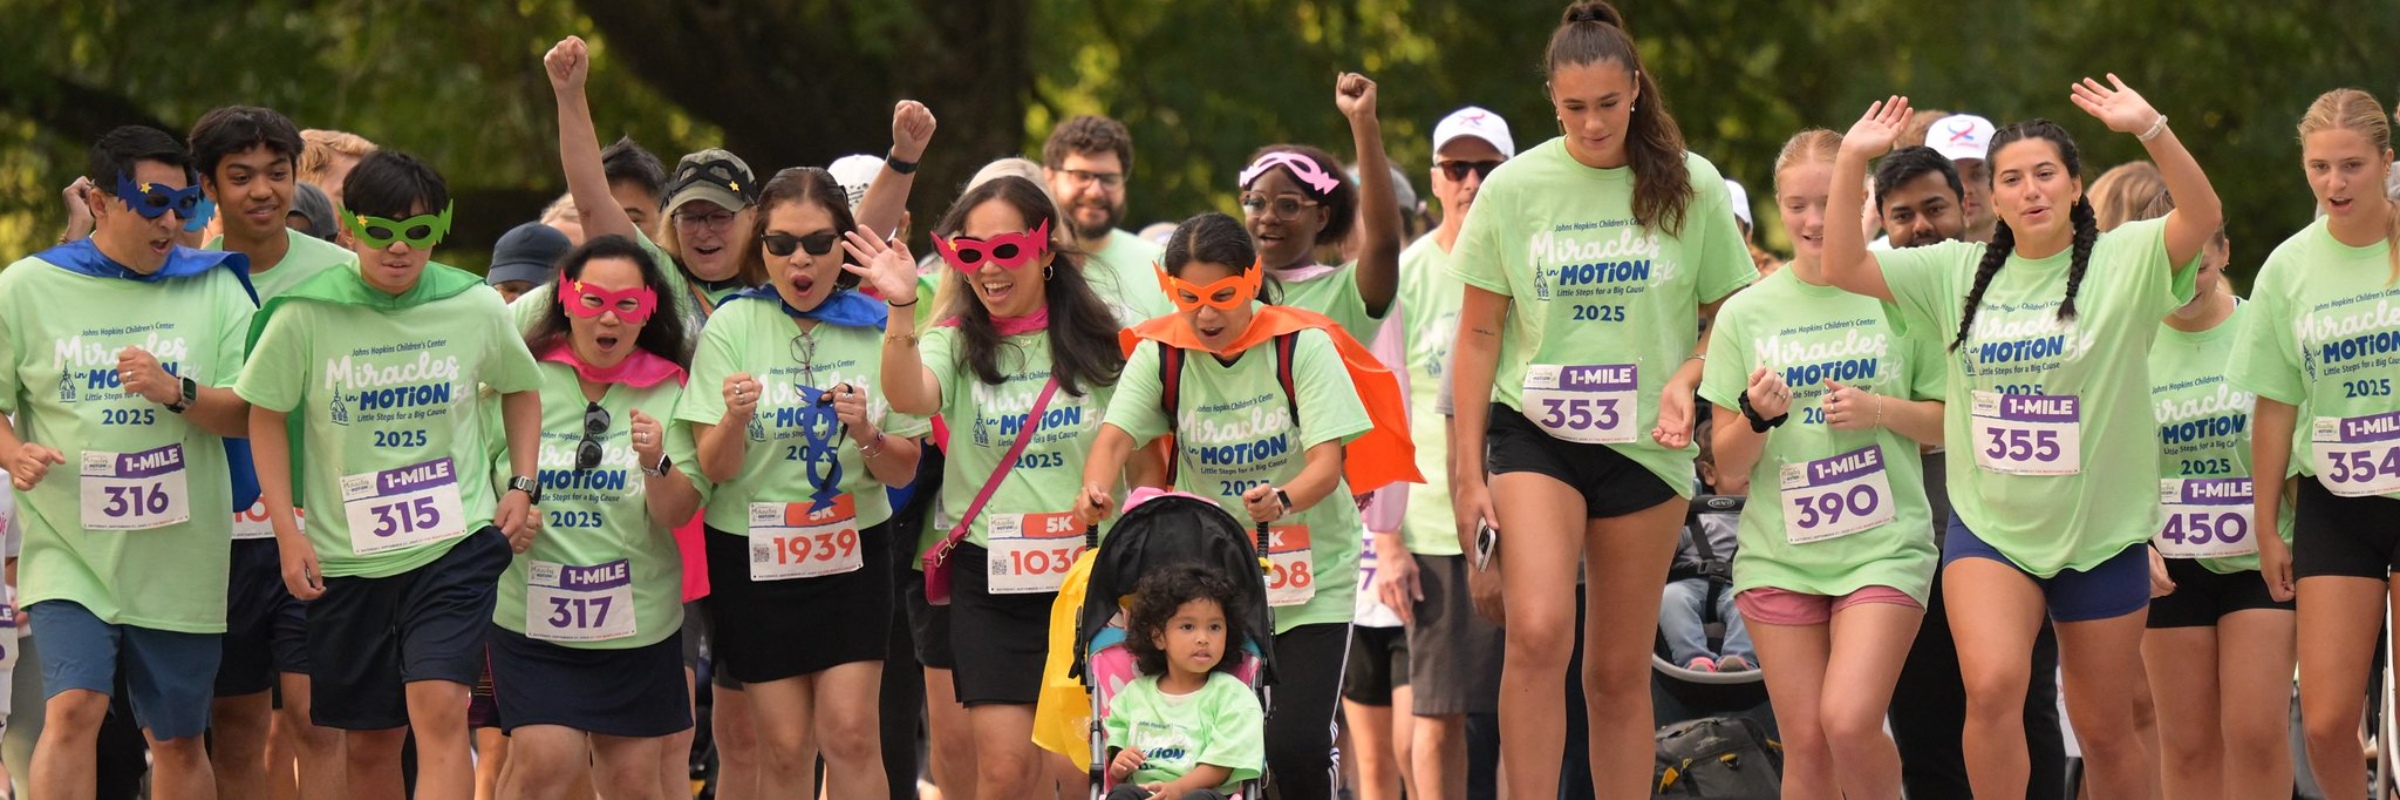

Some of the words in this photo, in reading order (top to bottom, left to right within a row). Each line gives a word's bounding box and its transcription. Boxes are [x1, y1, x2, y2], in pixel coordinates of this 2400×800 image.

[1574, 222, 1598, 231] Hopkins
[1529, 228, 1660, 267] Miracles
[1575, 287, 1594, 297] Steps
[1573, 304, 1625, 322] 2025
[100, 326, 124, 337] Hopkins
[155, 321, 175, 329] Center
[1798, 324, 1823, 334] Hopkins
[1856, 318, 1876, 326] Center
[2296, 299, 2400, 350] Miracle
[371, 346, 395, 355] Hopkins
[396, 342, 426, 352] Children's
[427, 340, 446, 348] Center
[1755, 329, 1889, 368] Miracles
[325, 351, 459, 390] Miracles
[837, 359, 856, 367] Center
[1995, 366, 2012, 376] Steps
[1570, 368, 1632, 385] 1-MILE
[2169, 381, 2194, 390] Hopkins
[2343, 379, 2391, 398] 2025
[357, 414, 375, 422] Little
[377, 411, 395, 422] Steps
[396, 410, 406, 419] for
[414, 410, 425, 419] Big
[427, 408, 447, 416] Cause
[1540, 399, 1620, 430] 353
[2009, 398, 2073, 415] 1-MILE
[102, 408, 155, 425] 2025
[986, 417, 999, 425] in
[1178, 406, 1291, 443] Miracles
[2347, 415, 2400, 437] 1-MIL
[374, 430, 427, 447] 2025
[1058, 431, 1078, 440] Cause
[1985, 427, 2061, 462] 355
[125, 448, 179, 472] 1-MILE
[1815, 449, 1877, 479] 1-MILE
[2181, 458, 2231, 475] 2025
[2328, 446, 2400, 483] 354
[385, 462, 449, 488] 1-MILE
[1201, 467, 1217, 475] Little
[1218, 466, 1236, 476] Steps
[1239, 466, 1247, 474] for
[1255, 463, 1267, 471] Big
[600, 494, 620, 502] Cause
[2191, 482, 2253, 498] 1-MILE
[103, 482, 169, 517] 316
[1794, 484, 1878, 529] 390
[371, 496, 440, 537] 315
[551, 511, 603, 528] 2025
[1046, 515, 1074, 533] 5K
[2162, 512, 2248, 545] 450
[773, 528, 857, 565] 1939
[568, 563, 625, 585] 1-MILE
[548, 596, 613, 628] 317
